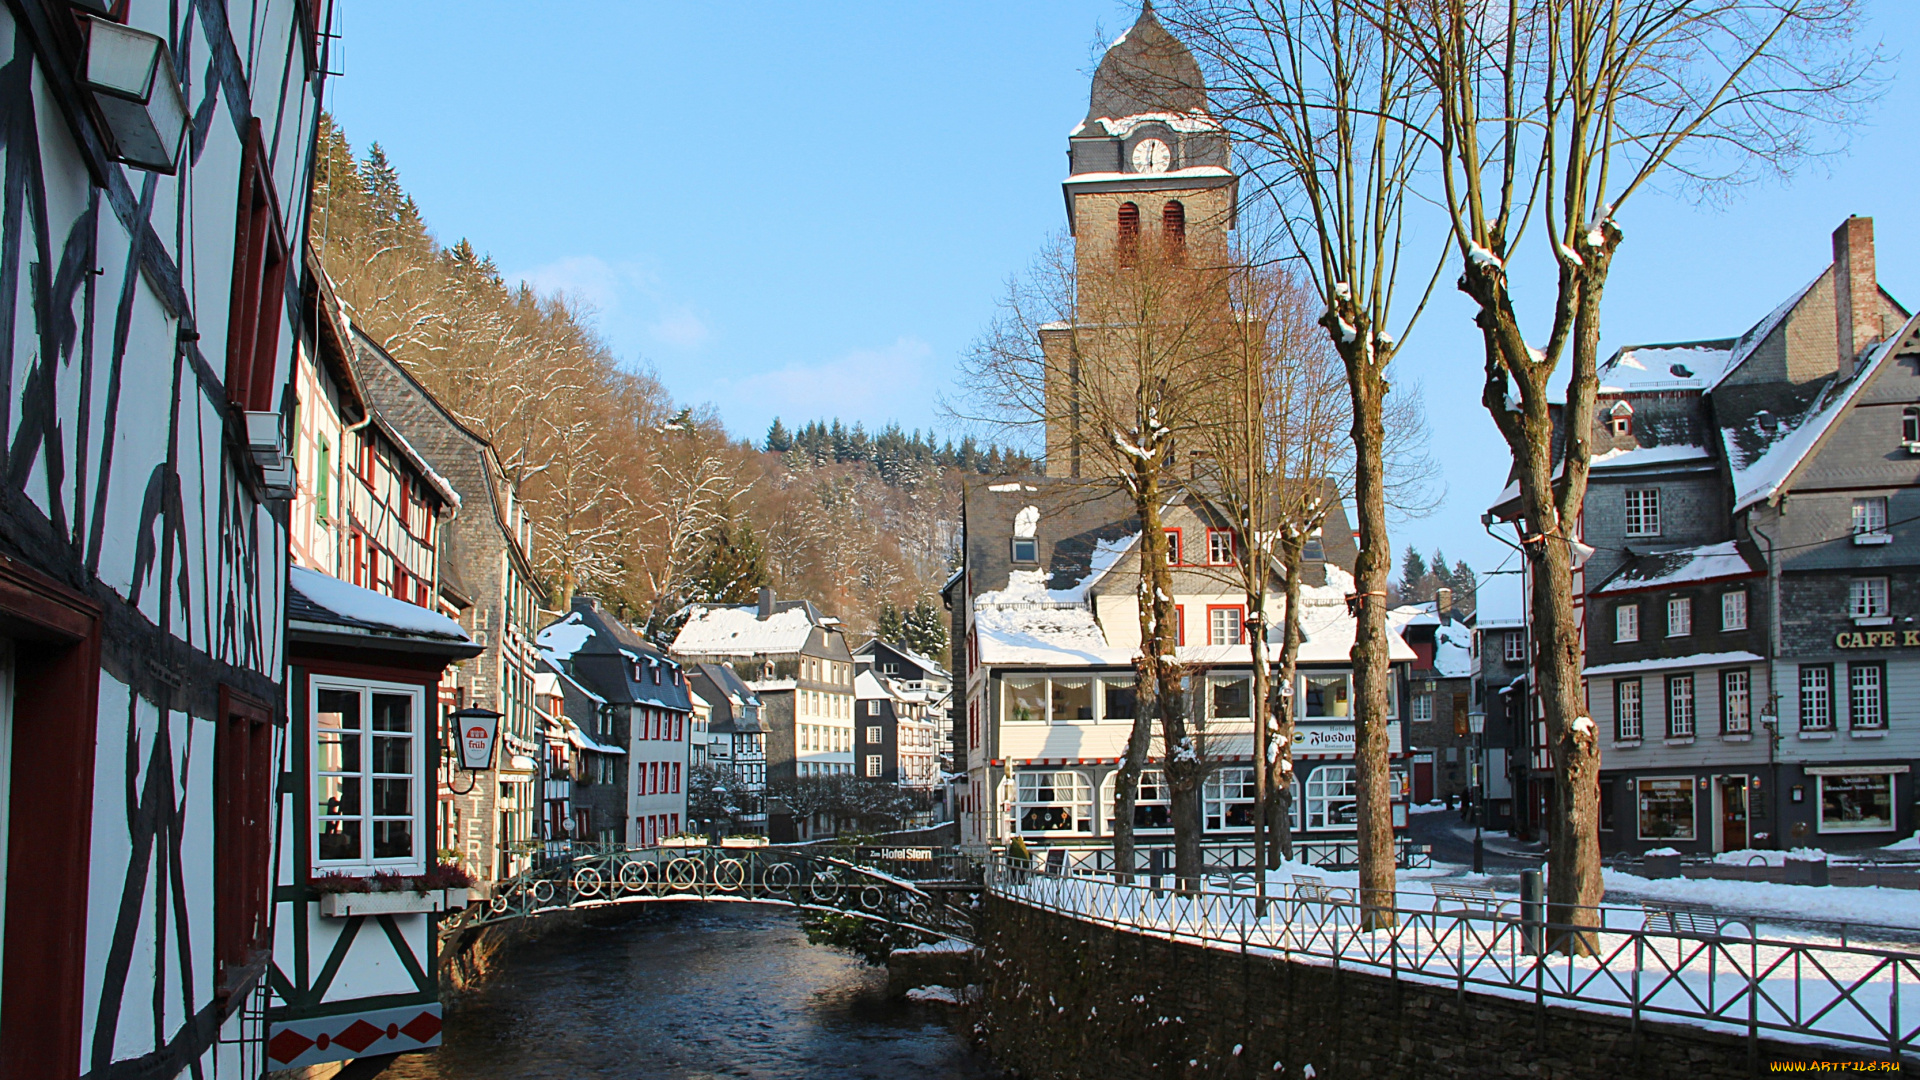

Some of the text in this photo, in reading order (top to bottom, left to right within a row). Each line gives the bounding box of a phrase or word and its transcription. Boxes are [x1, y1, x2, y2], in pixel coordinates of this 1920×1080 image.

[1836, 631, 1896, 648] CAFE
[468, 740, 486, 749] früh
[881, 849, 905, 859] Hotel
[906, 849, 931, 859] Stern
